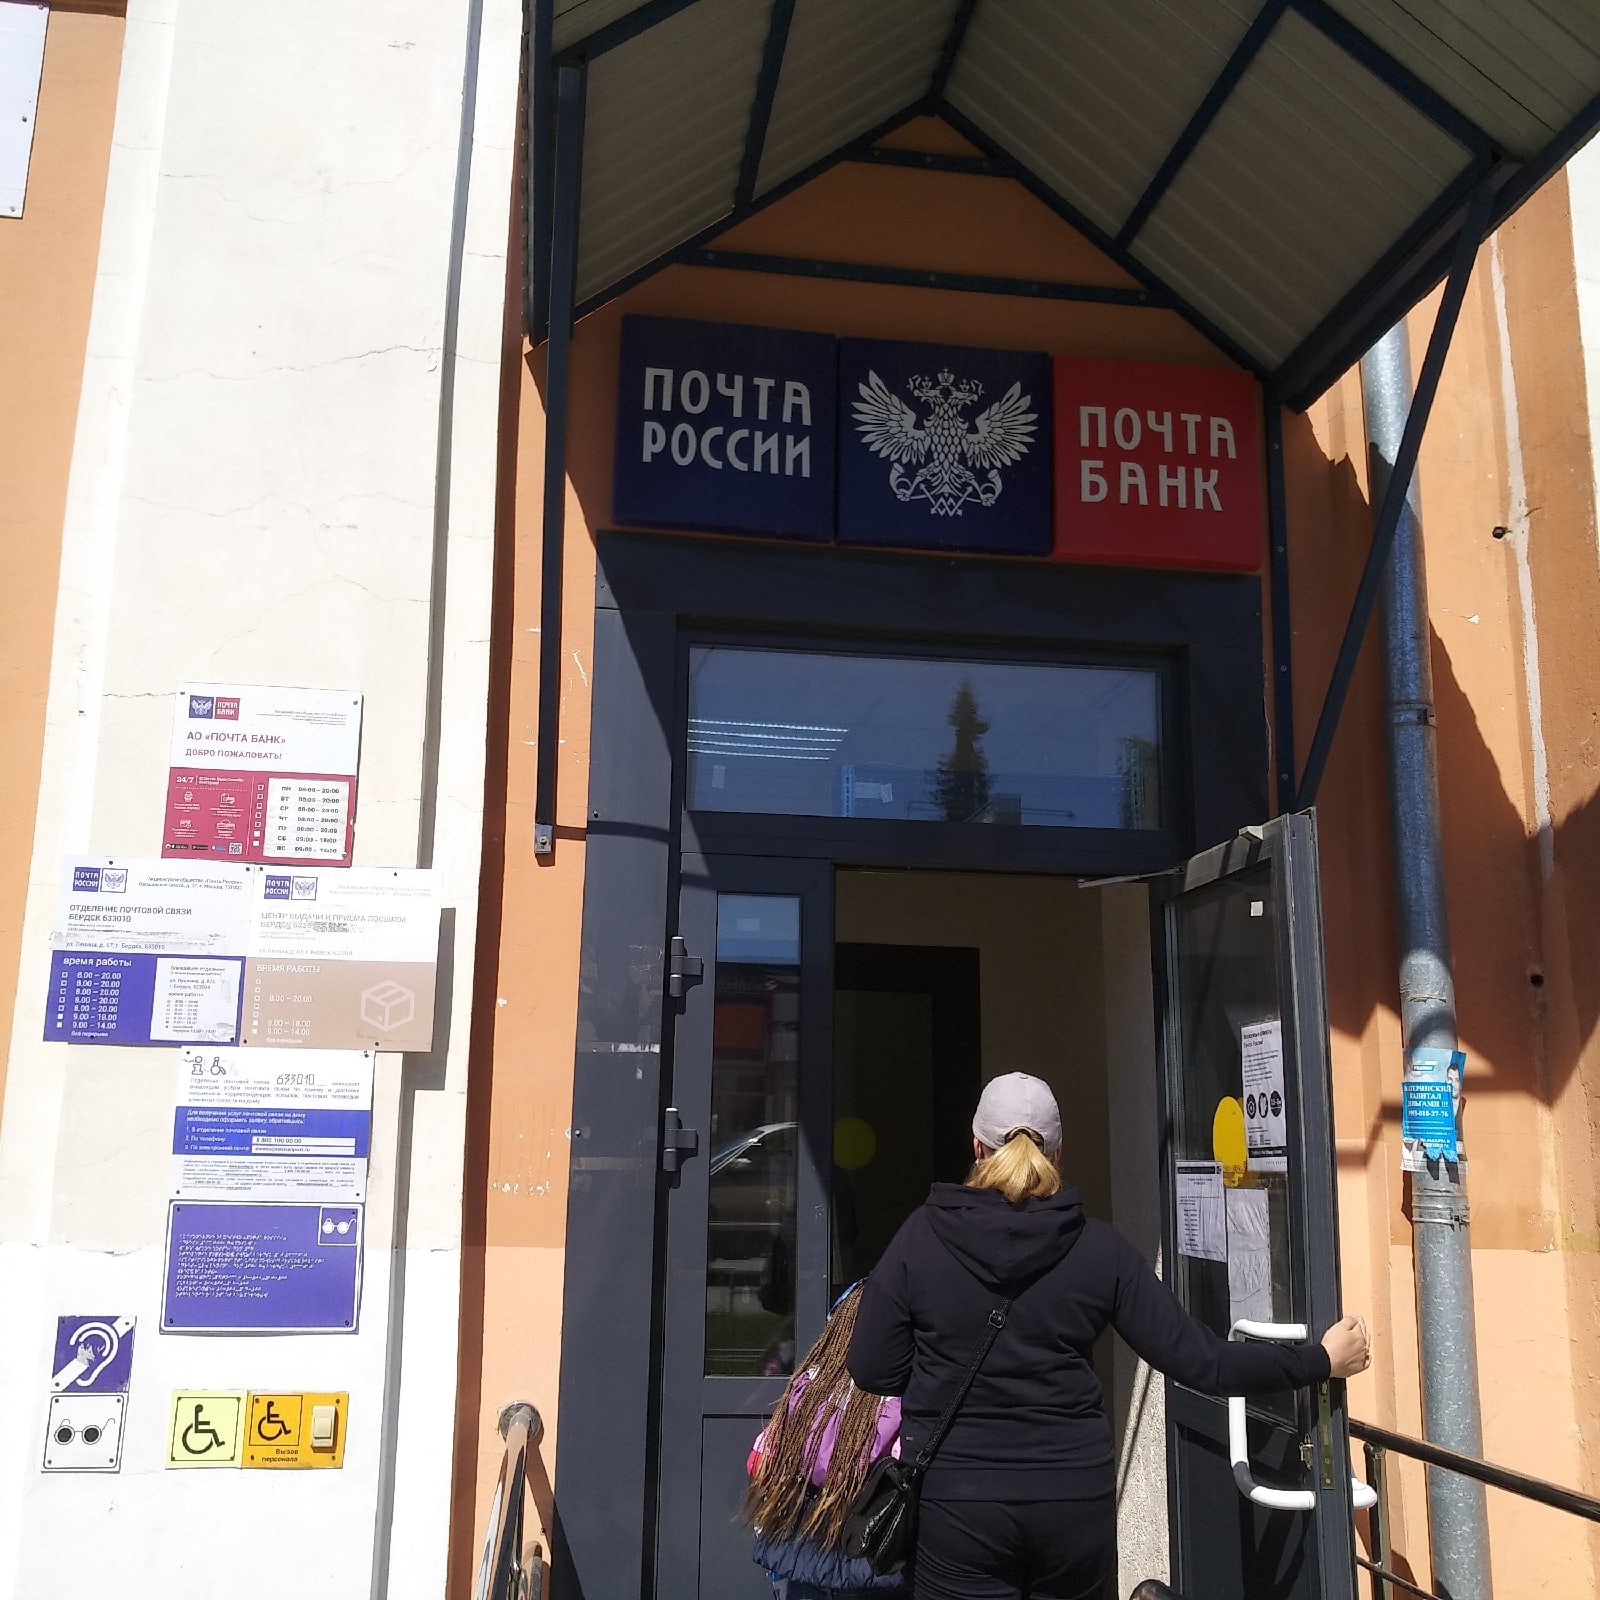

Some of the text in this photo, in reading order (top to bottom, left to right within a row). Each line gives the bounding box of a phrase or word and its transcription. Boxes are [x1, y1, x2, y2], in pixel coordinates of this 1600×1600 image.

[643, 366, 812, 426] ПОЧТА
[1079, 405, 1236, 459] ПОЧТА
[642, 420, 811, 478] РОССИИ
[1080, 459, 1224, 511] БАНК
[187, 732, 286, 744] АО «ПОЧТА БАНК»
[185, 748, 282, 760] ДОБРО ПОЖАЛОВАТЬ!
[176, 776, 194, 784] 24/7
[75, 871, 99, 879] ПОЧТА
[70, 905, 117, 913] ОТДЕЛЕНИЕ
[120, 906, 163, 915] ПОЧТОВОЙ
[69, 914, 131, 922] БЕРДСК 633010
[290, 914, 324, 922] ВЫДАЧИ
[64, 958, 131, 967] время работы
[101, 972, 121, 980] 20.00
[97, 1022, 116, 1030] 14.00
[277, 1074, 315, 1085] 633010
